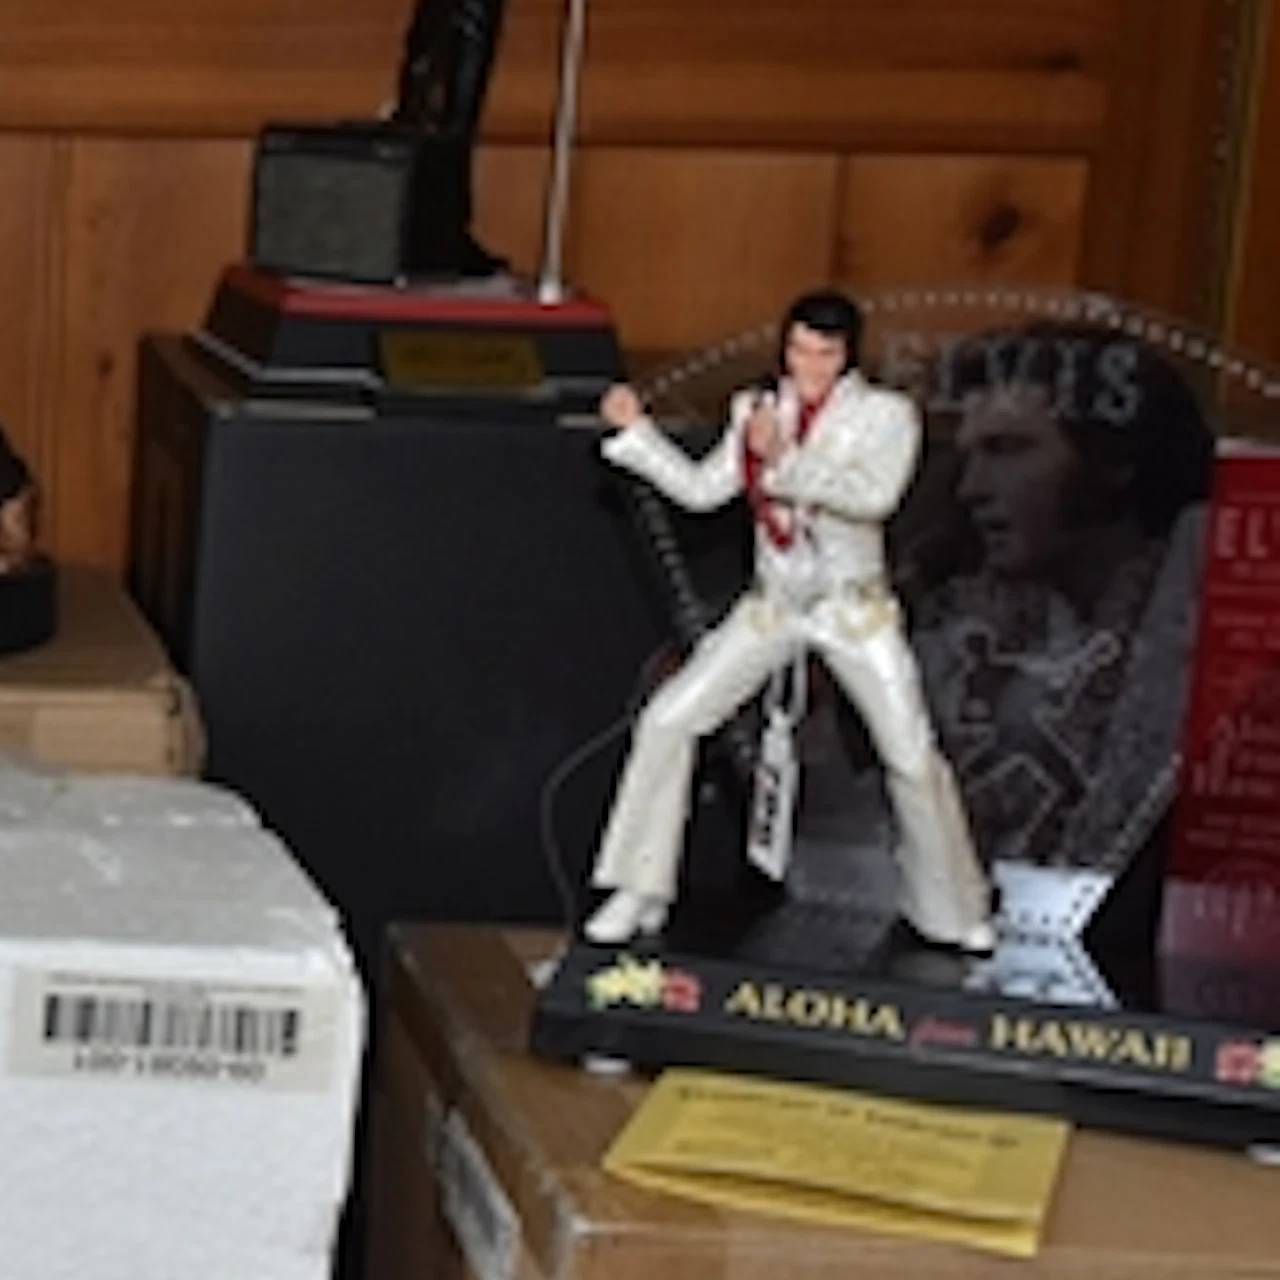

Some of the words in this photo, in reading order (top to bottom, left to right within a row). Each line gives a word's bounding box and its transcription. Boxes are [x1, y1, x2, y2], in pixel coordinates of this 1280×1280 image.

[884, 331, 1143, 425] ELVIS
[1215, 504, 1280, 559] EL
[724, 979, 907, 1041] ALOHA
[989, 1012, 1194, 1071] HAWAII
